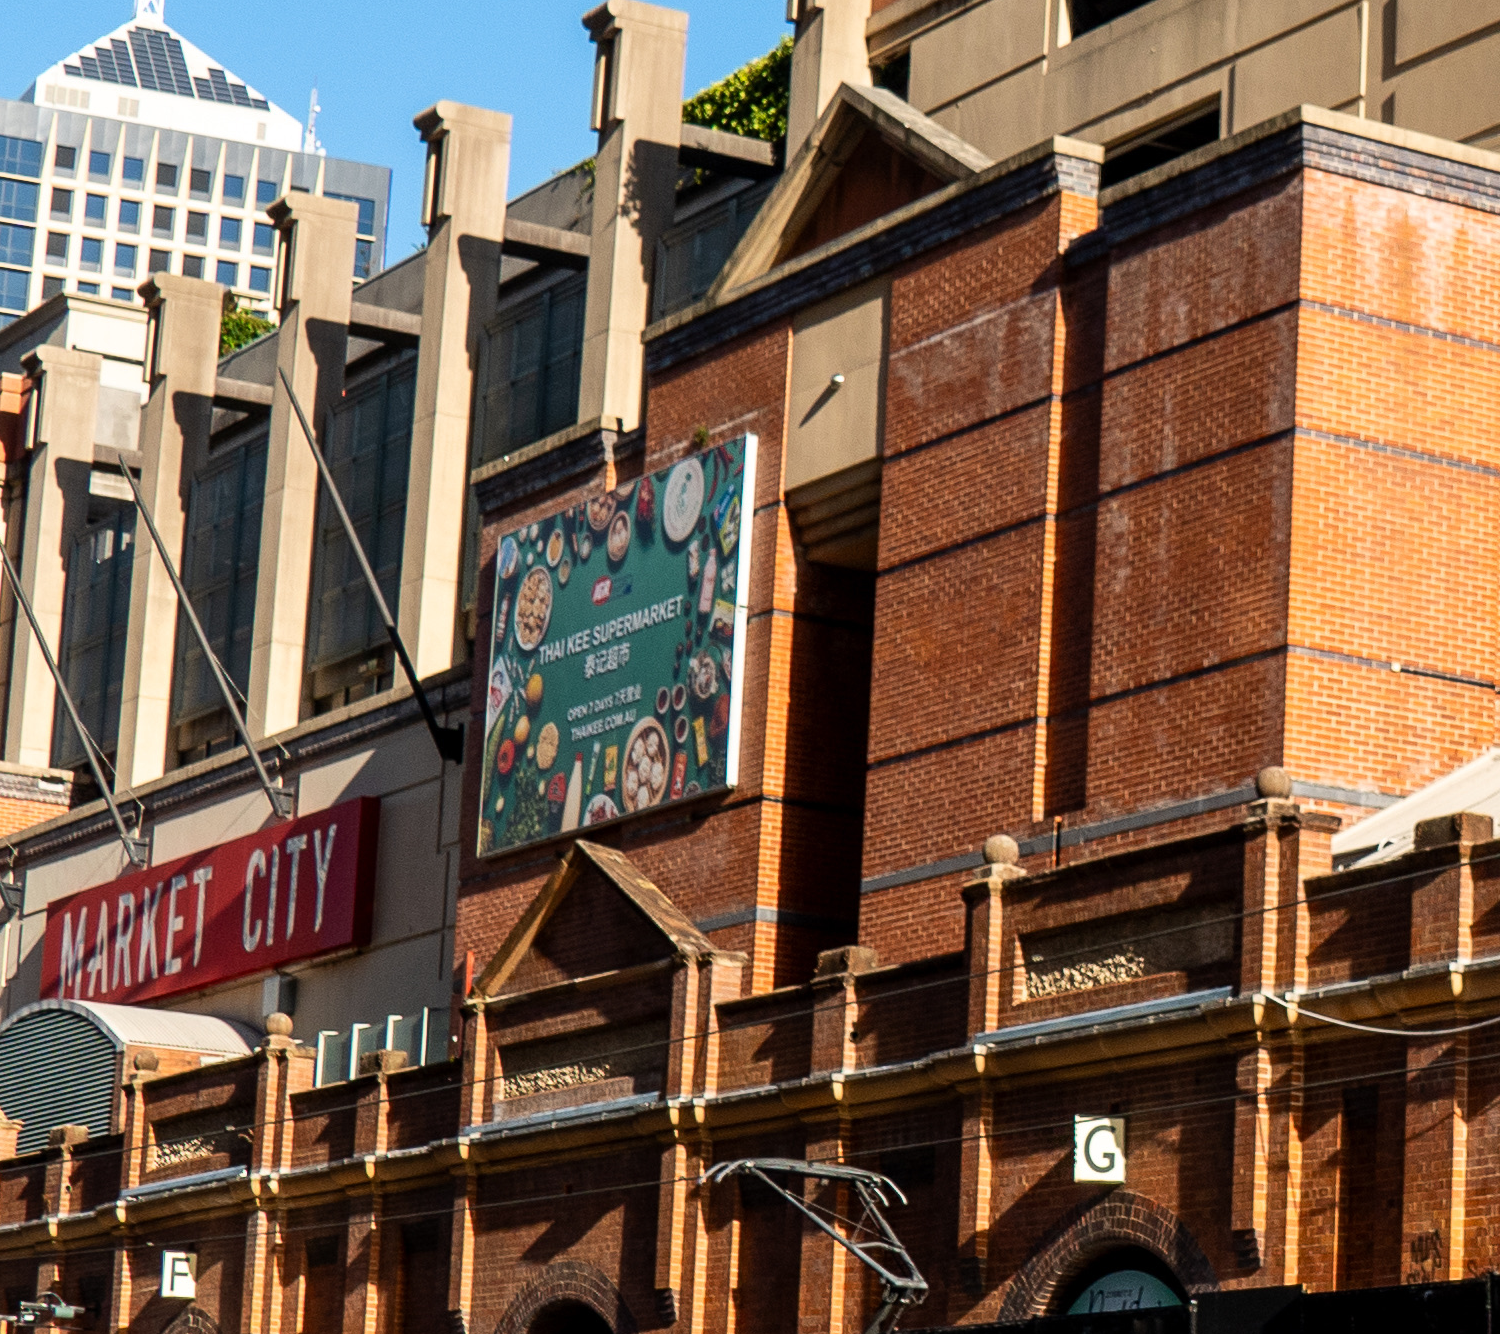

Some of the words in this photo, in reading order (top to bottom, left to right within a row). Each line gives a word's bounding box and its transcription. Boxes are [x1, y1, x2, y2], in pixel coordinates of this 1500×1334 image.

[539, 639, 566, 665] THAI
[566, 629, 591, 655] KEE
[592, 594, 684, 646] SUPERMARKET
[567, 705, 588, 721] OPEN
[594, 694, 613, 713] DAYS
[59, 866, 213, 1000] MARKET
[242, 824, 338, 953] CITY
[1084, 1124, 1117, 1173] G
[170, 1257, 190, 1291] F
